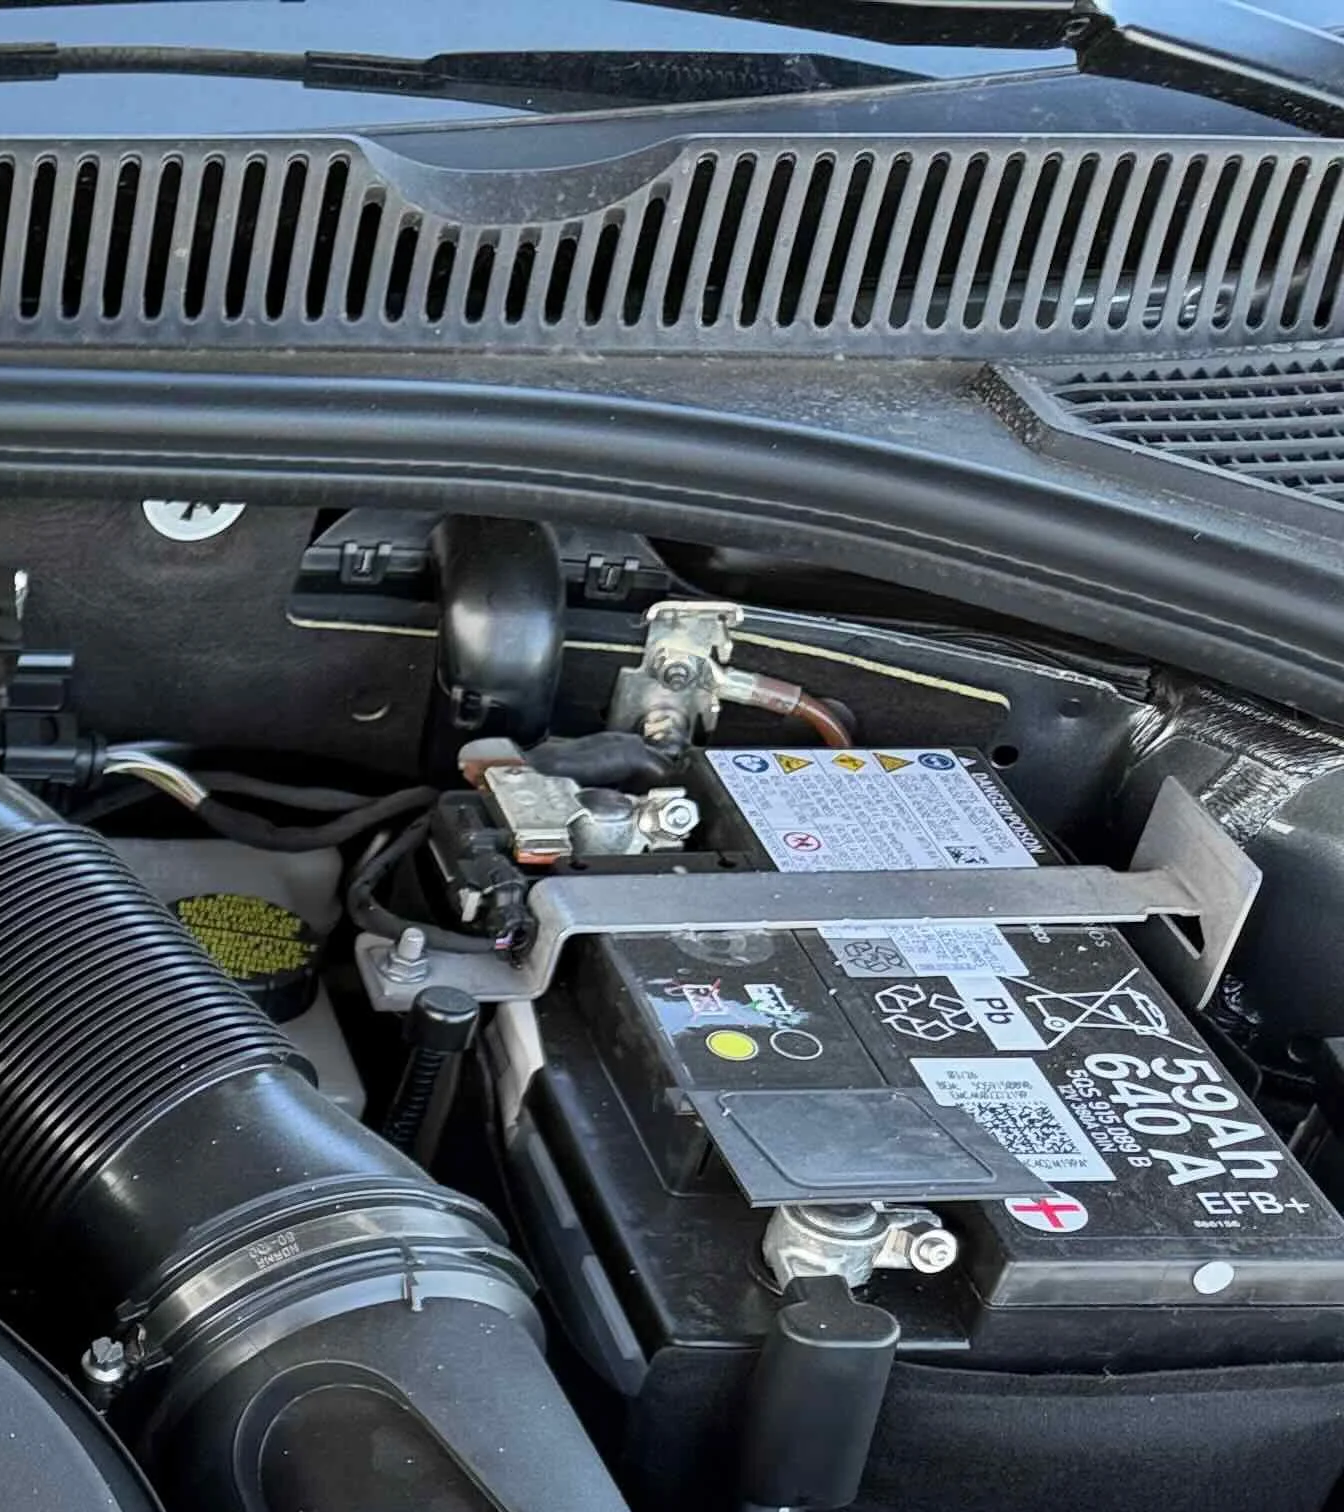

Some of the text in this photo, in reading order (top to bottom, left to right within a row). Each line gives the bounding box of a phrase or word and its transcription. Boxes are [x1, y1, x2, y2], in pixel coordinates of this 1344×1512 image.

[971, 771, 1047, 854] DANGER/POISON
[977, 997, 1014, 1025] Pb
[1084, 1053, 1192, 1136] 640
[1147, 1149, 1227, 1186] A
[1150, 1057, 1285, 1180] 59Ah
[1090, 1131, 1118, 1153] DIN
[1127, 1156, 1153, 1169] B
[1196, 1191, 1310, 1215] EFB+
